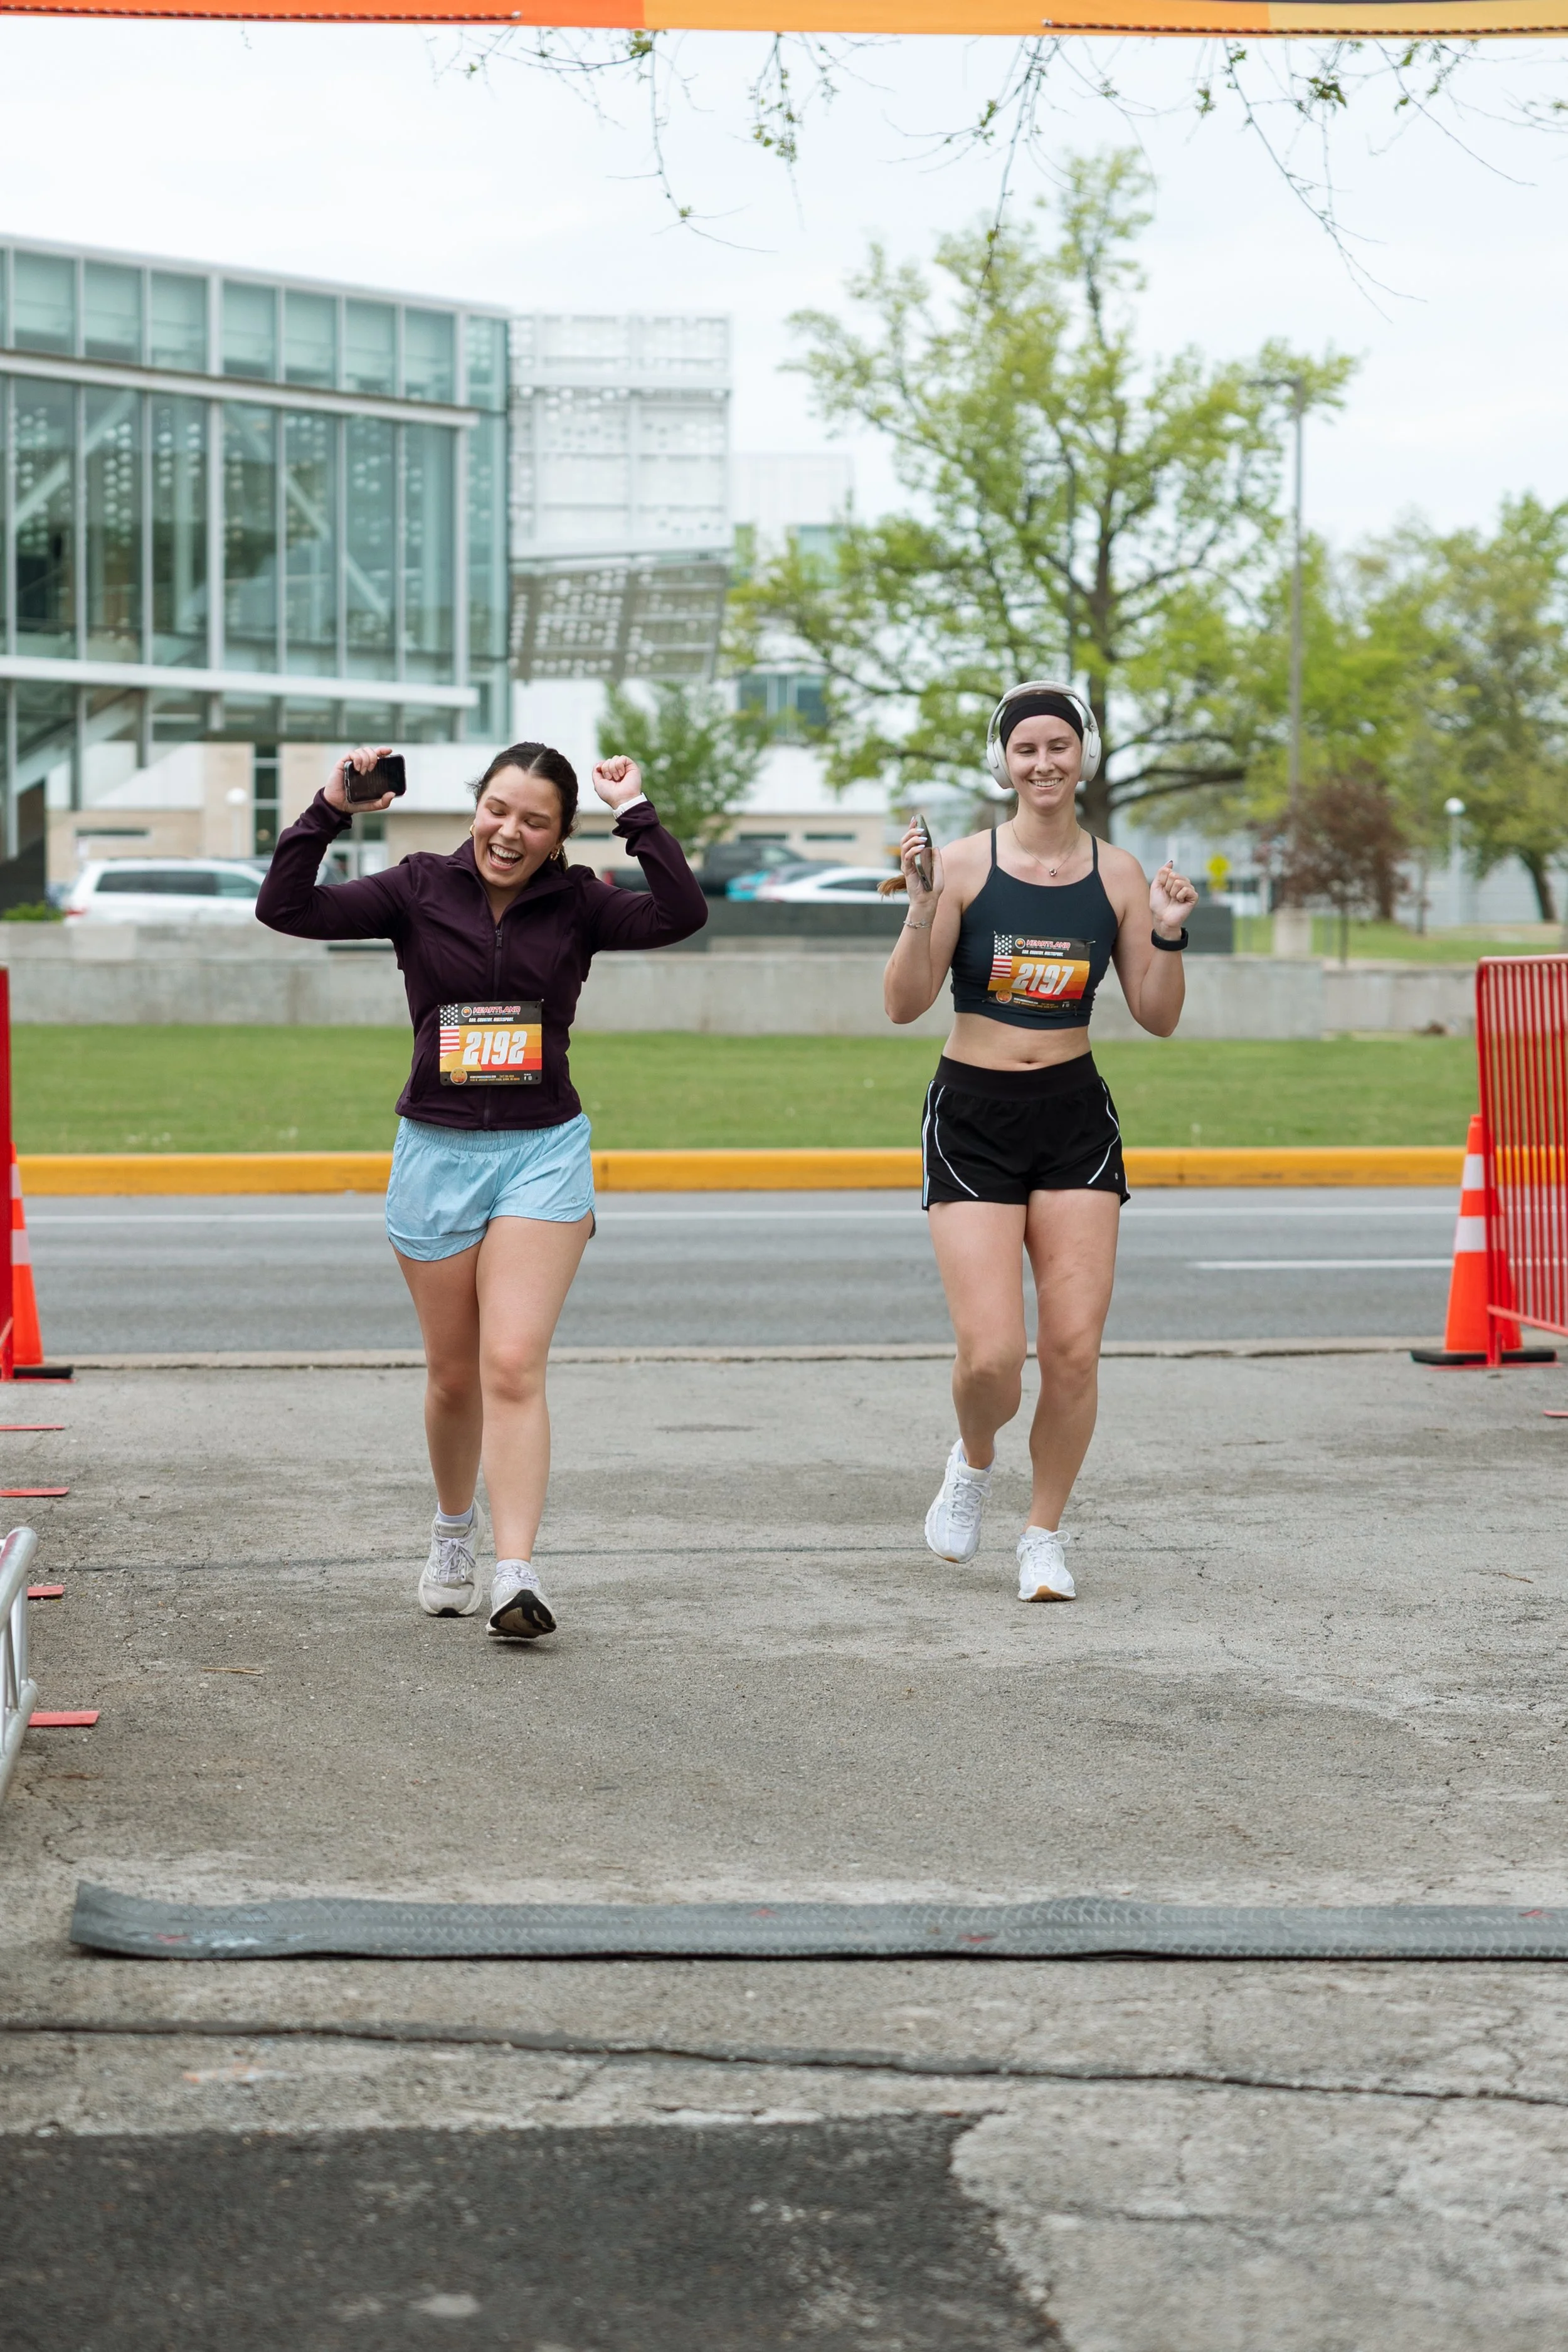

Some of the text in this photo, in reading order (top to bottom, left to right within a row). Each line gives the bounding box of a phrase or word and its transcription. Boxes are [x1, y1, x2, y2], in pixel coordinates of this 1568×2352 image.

[1026, 940, 1071, 948] HEARTLAND
[1012, 963, 1074, 995] 2197
[462, 1031, 527, 1065] 2192
